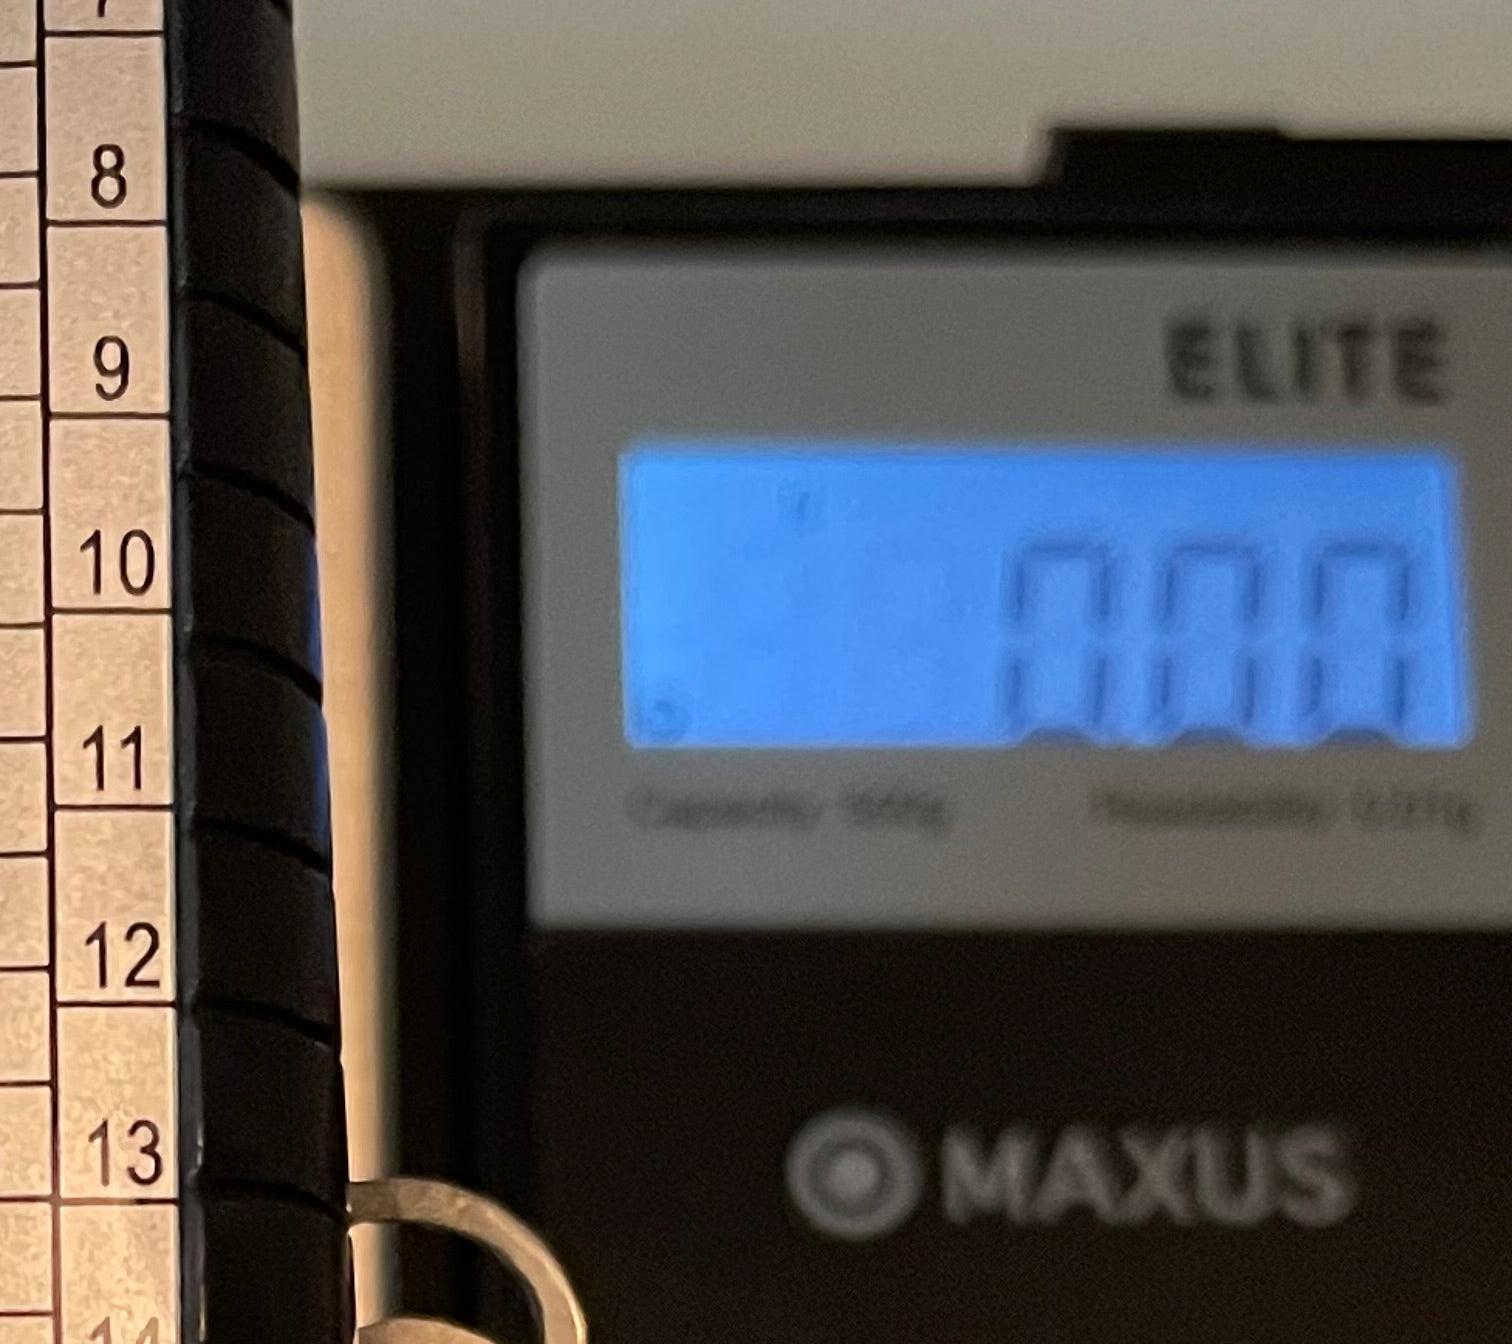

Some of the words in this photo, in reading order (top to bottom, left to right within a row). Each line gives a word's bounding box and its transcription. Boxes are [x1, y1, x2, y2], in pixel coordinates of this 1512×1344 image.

[90, 144, 127, 208] 8
[93, 335, 130, 400] 9
[1162, 316, 1448, 402] ELITE
[80, 529, 155, 596] 10
[82, 725, 143, 791] 11
[85, 922, 161, 989] 12
[88, 1119, 163, 1187] 13
[938, 1120, 1358, 1228] MAXUS
